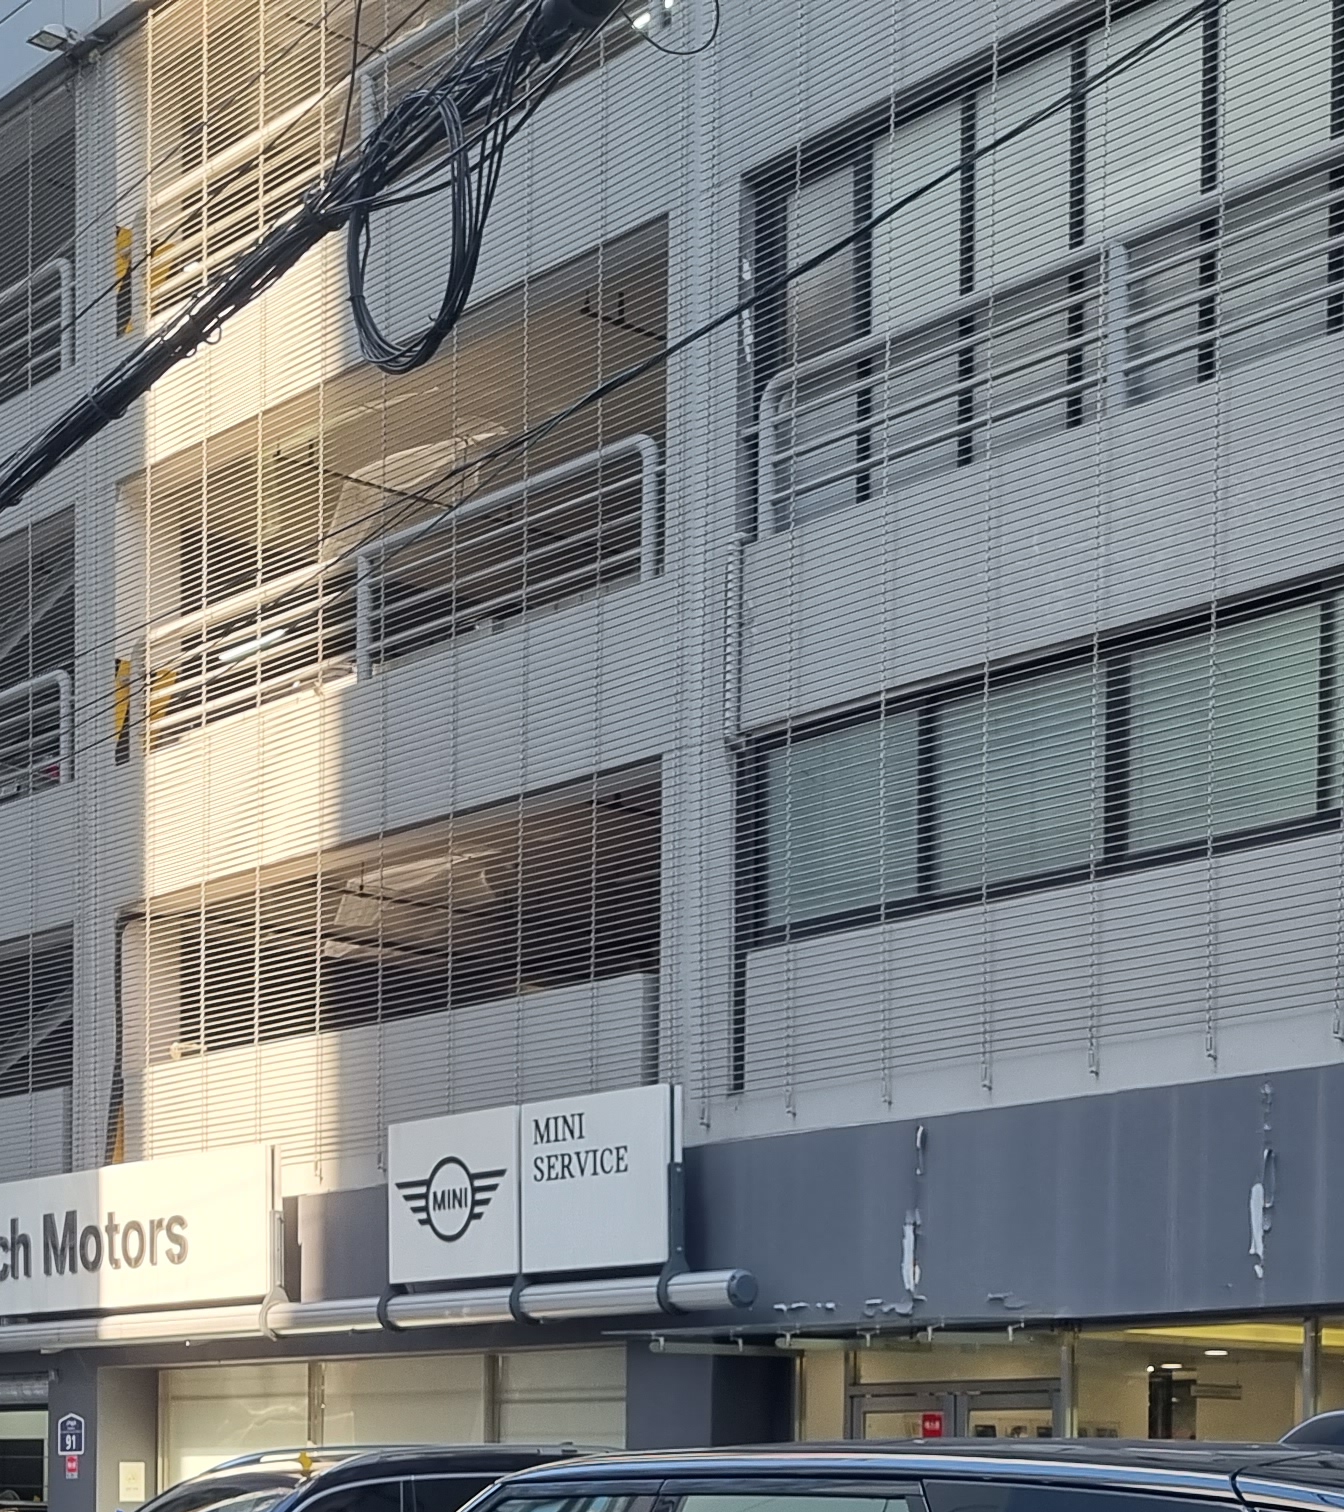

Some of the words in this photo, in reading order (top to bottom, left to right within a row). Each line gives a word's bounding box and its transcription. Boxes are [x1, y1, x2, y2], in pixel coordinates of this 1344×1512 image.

[532, 1112, 585, 1145] MINI
[533, 1145, 629, 1182] SERVICE
[432, 1187, 468, 1212] MINI
[42, 1210, 189, 1277] Motors
[65, 1434, 76, 1451] 91
